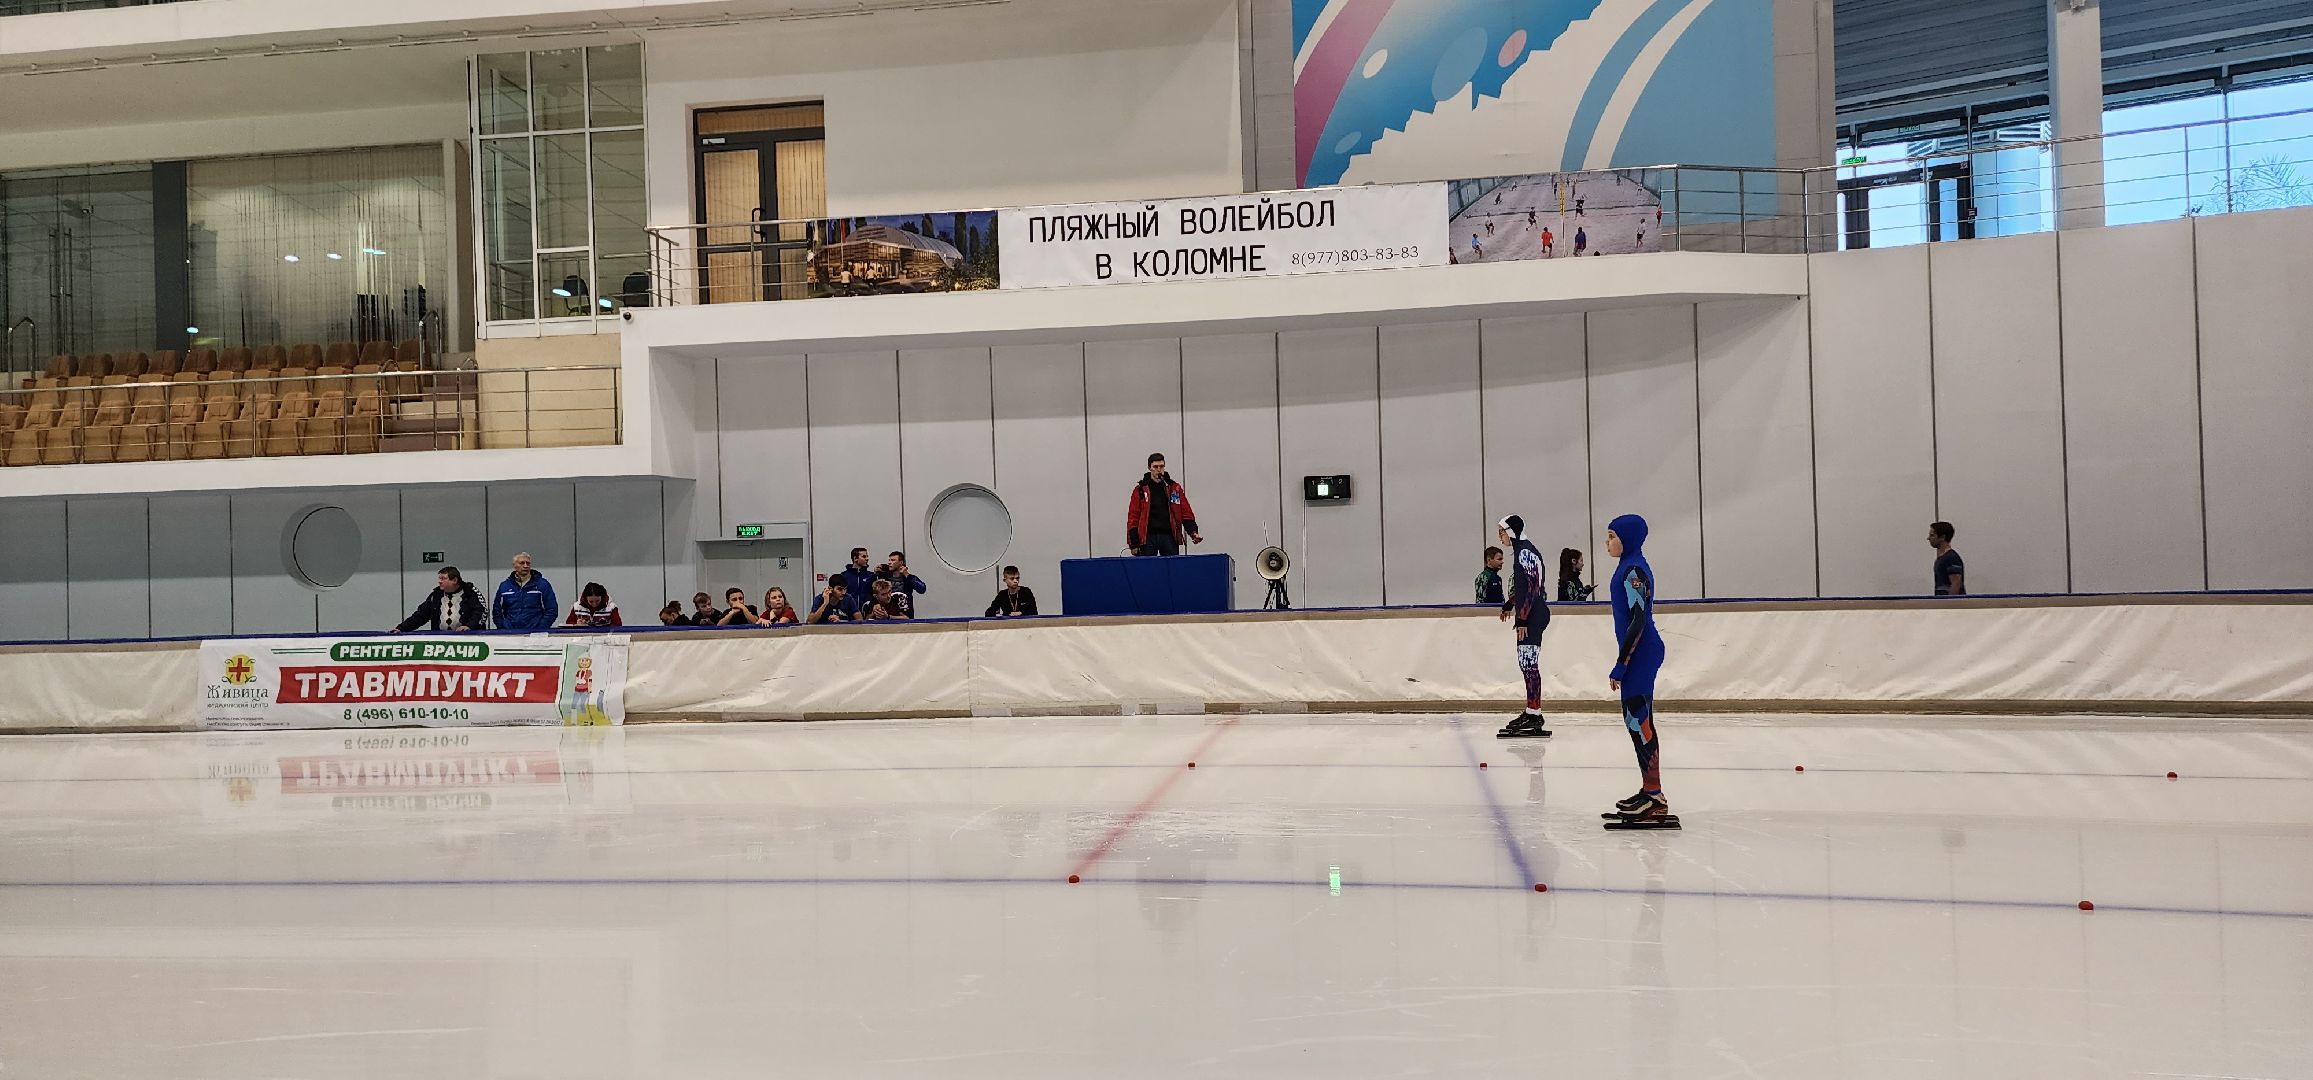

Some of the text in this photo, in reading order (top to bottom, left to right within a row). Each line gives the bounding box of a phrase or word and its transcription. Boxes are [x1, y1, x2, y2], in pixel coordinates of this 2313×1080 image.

[1029, 198, 1335, 243] ПЛЯЖНЫЙ ВОЛЕЙБОЛ
[1096, 245, 1266, 279] В КОЛОМНЕ
[1291, 246, 1419, 268] 8(977)803-83-83
[339, 644, 480, 658] РЕНТГЕН ВРАЧИ
[207, 685, 269, 702] Живица
[294, 670, 536, 699] ТРАВМПУНКТ
[343, 707, 469, 723] 8 (496) 610-10-10
